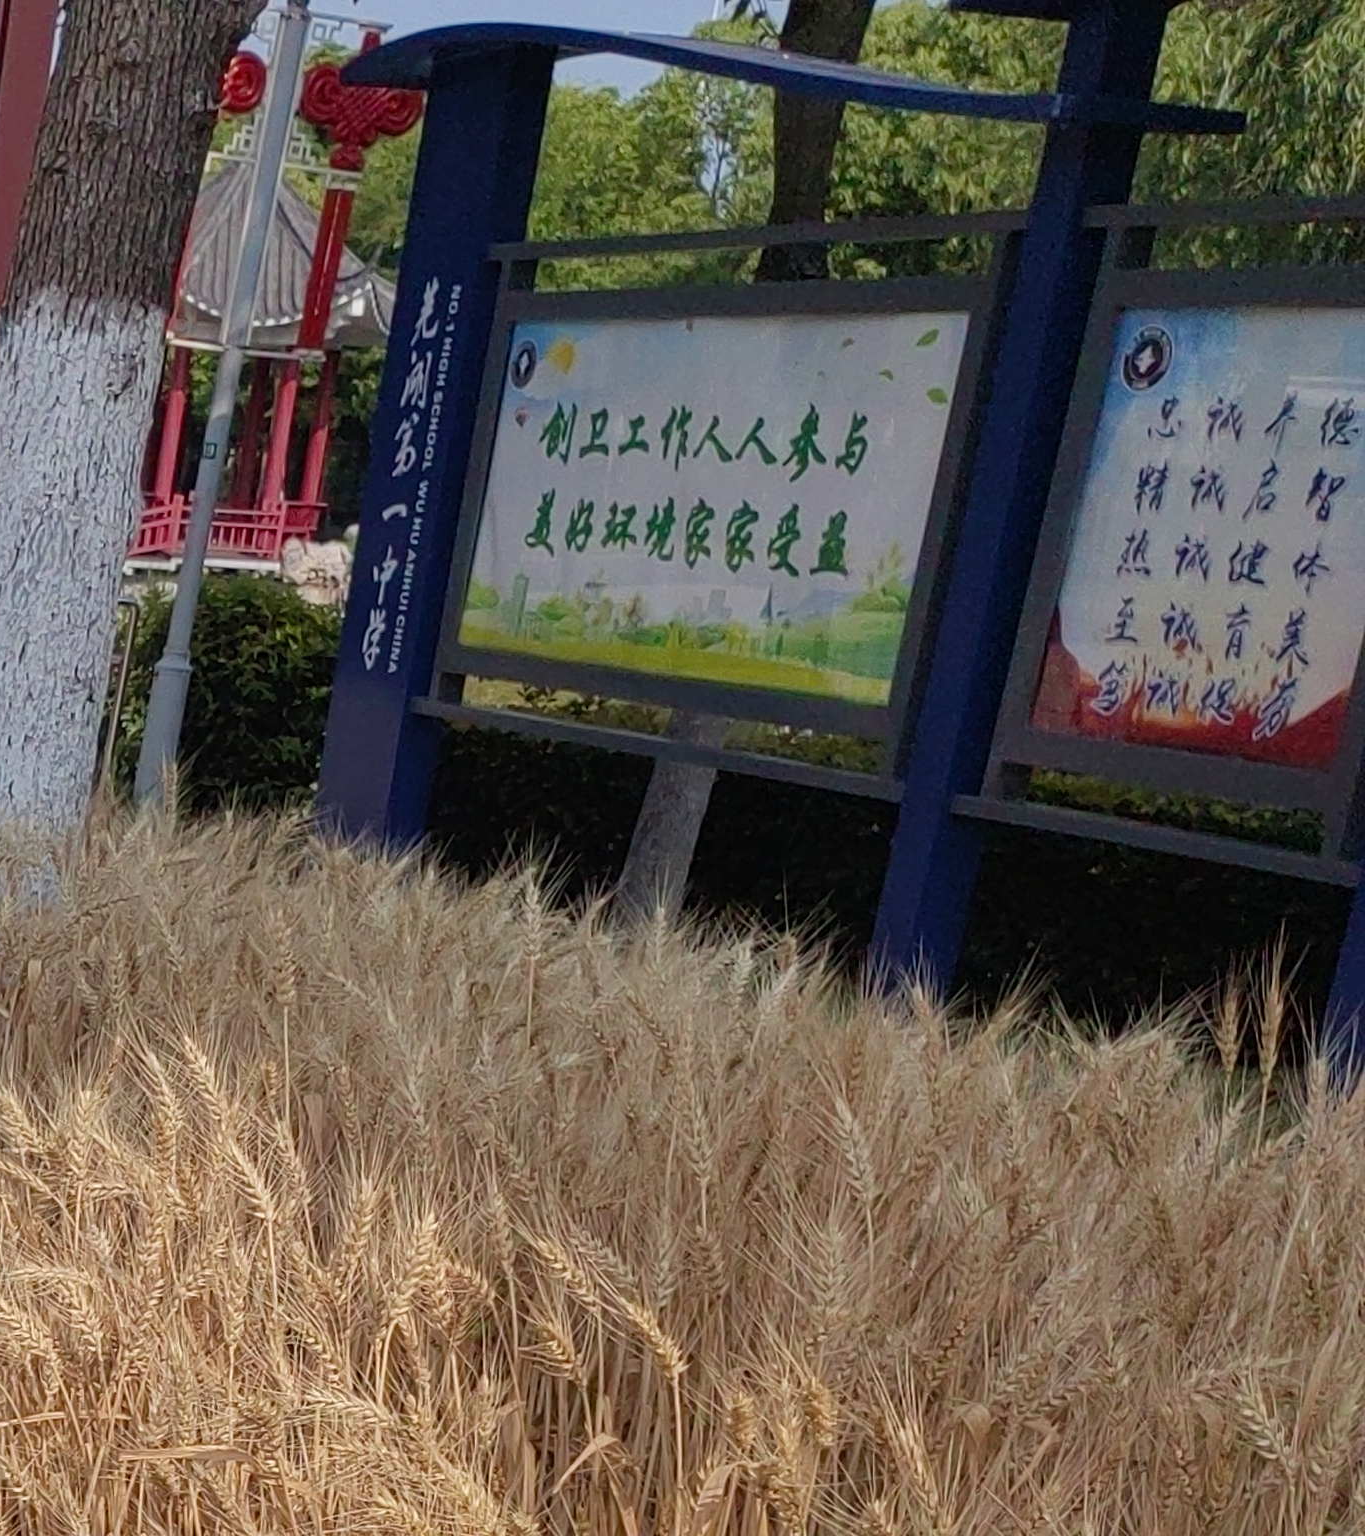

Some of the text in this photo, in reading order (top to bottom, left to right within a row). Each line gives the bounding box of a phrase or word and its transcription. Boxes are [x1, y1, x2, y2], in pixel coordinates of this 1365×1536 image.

[436, 337, 454, 386] HIGH
[421, 390, 444, 472] SCHOOL
[538, 401, 868, 482] 创卫工作人人参与
[1147, 390, 1359, 451] 忠诚养德
[1135, 458, 1345, 522] 精诚启智
[524, 487, 849, 578] 美好环境家家受益
[1117, 529, 1330, 595] 热诚健体
[398, 548, 417, 611] ANHUI
[387, 615, 406, 673] CHINA
[1104, 597, 1309, 665] 至诚育美
